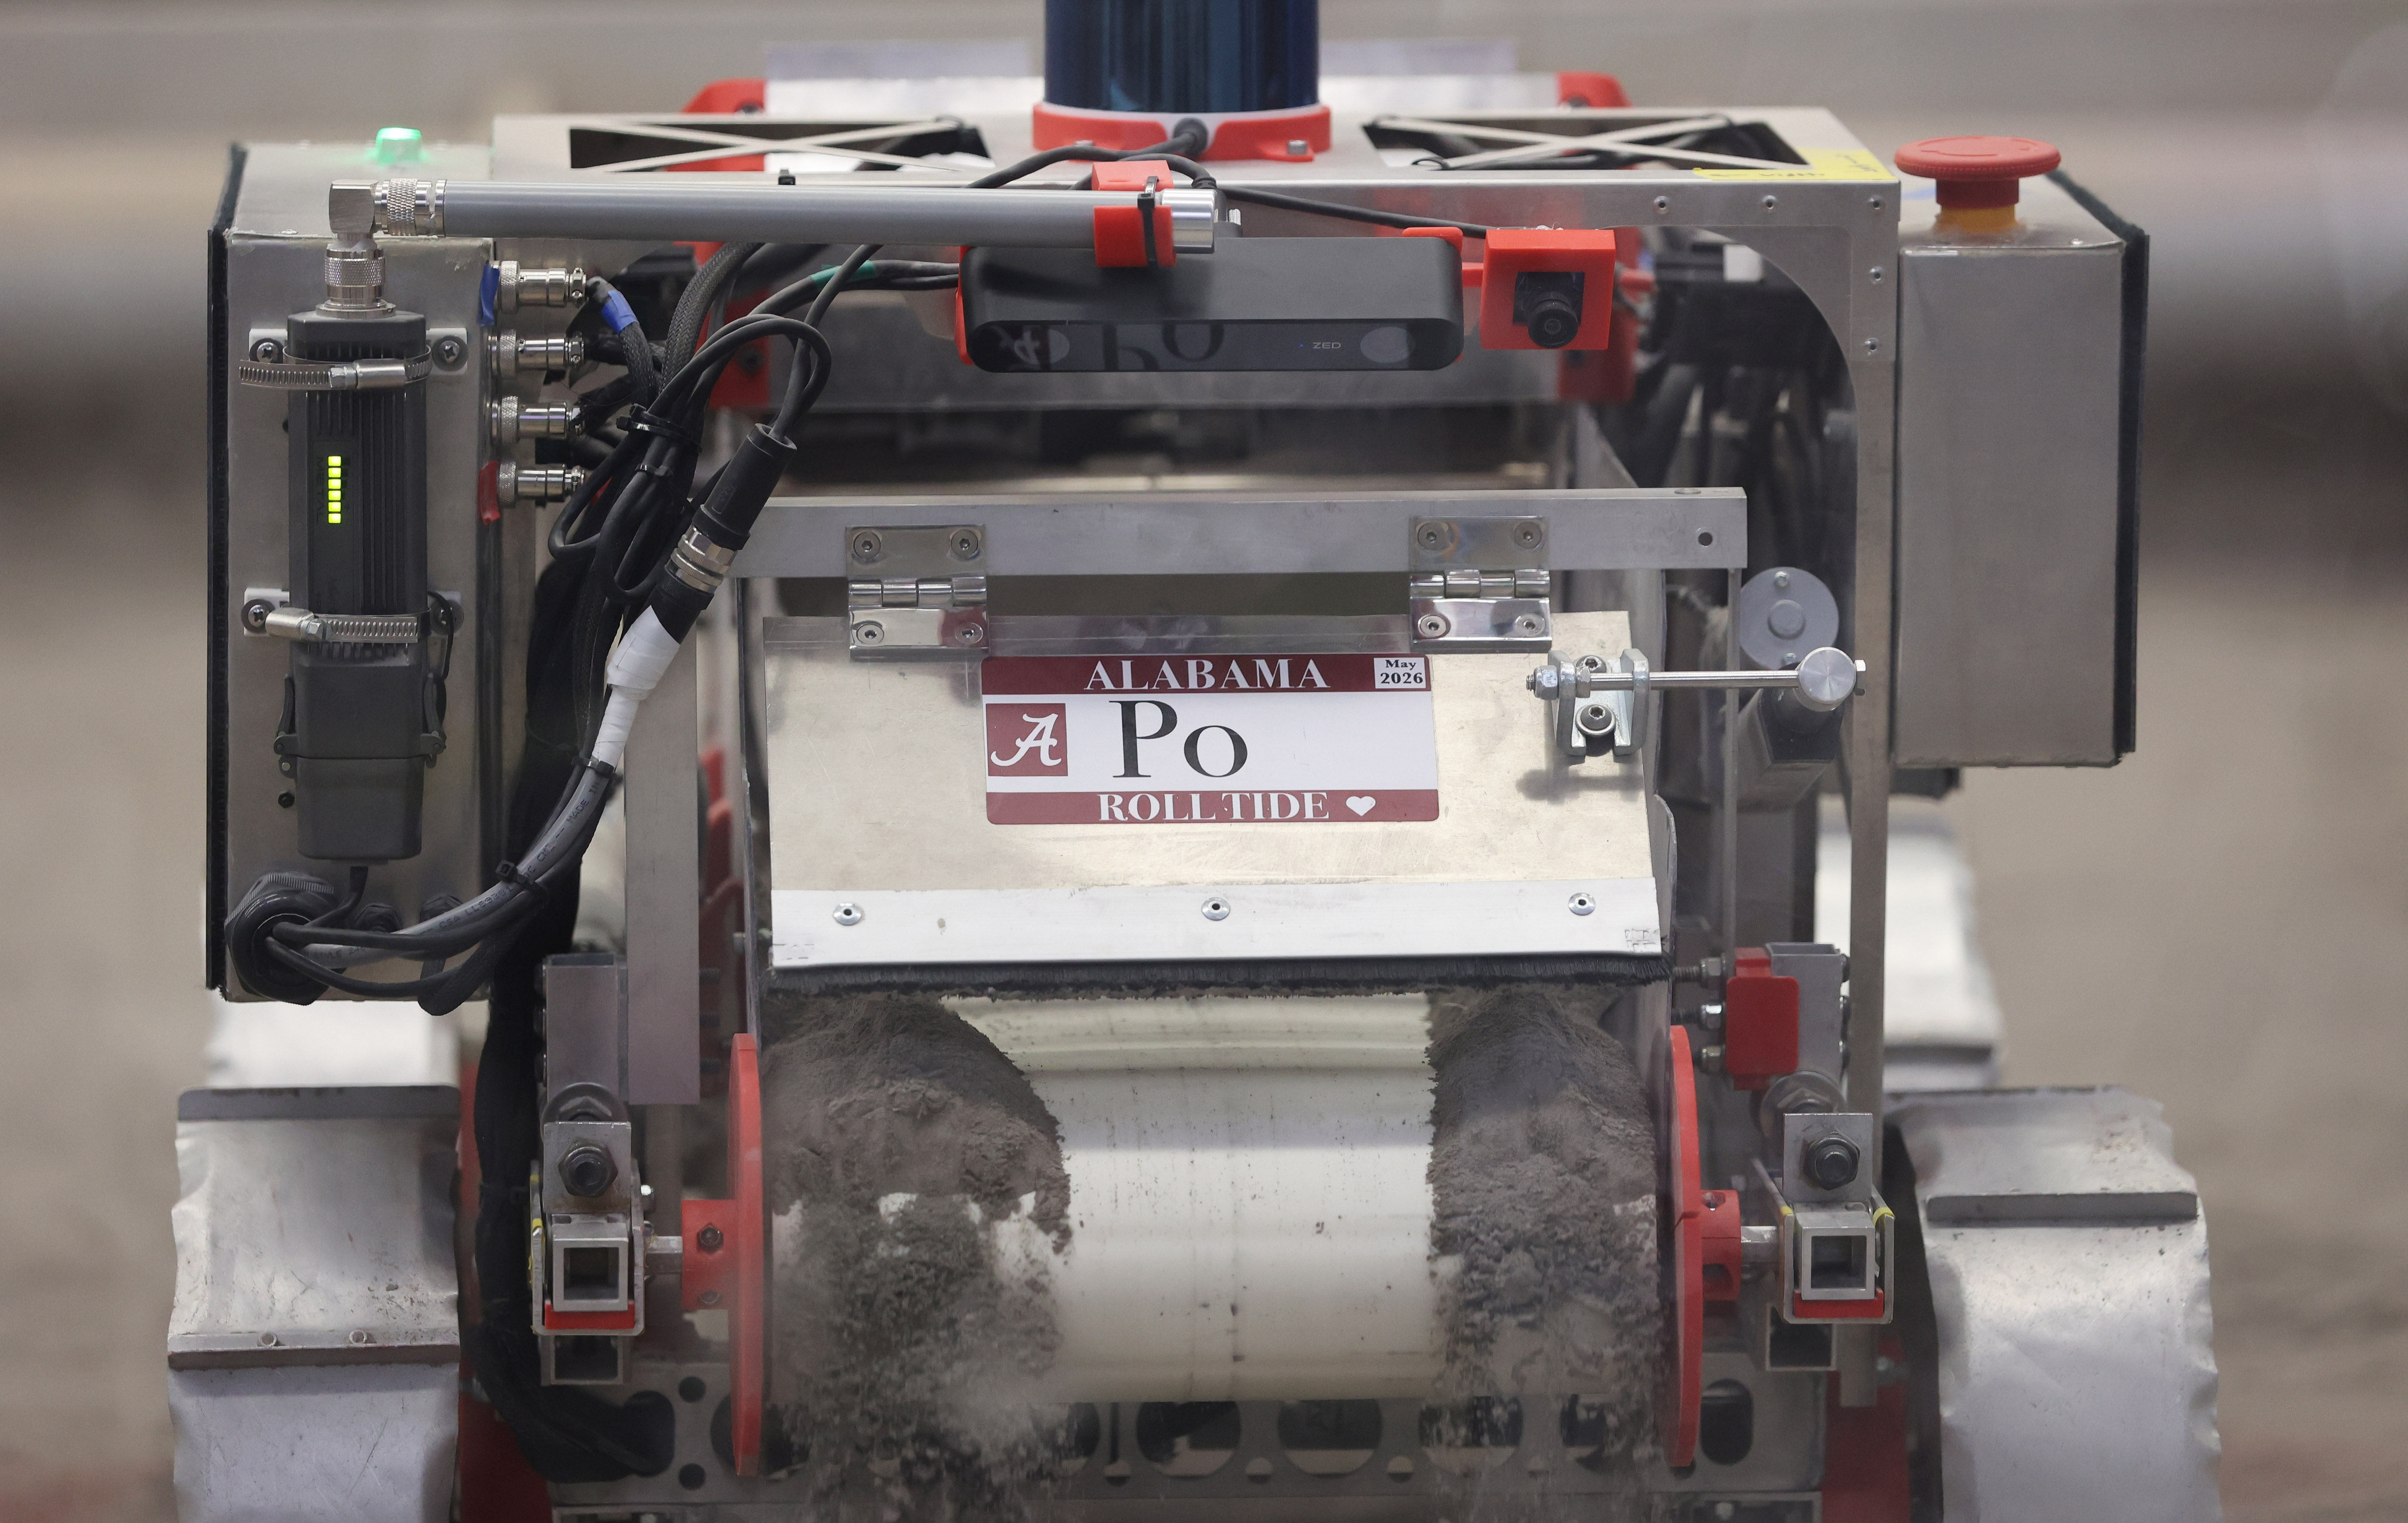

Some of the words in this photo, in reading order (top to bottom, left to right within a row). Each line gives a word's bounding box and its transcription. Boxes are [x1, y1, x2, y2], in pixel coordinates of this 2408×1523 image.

[1083, 658, 1331, 690] ALABAMA
[1380, 672, 1423, 684] 2026
[1385, 659, 1416, 670] May
[991, 713, 1062, 766] A
[1109, 700, 1248, 778] Po
[566, 799, 590, 822] MADE
[1097, 793, 1216, 821] ROLL
[1221, 792, 1329, 820] TIDE
